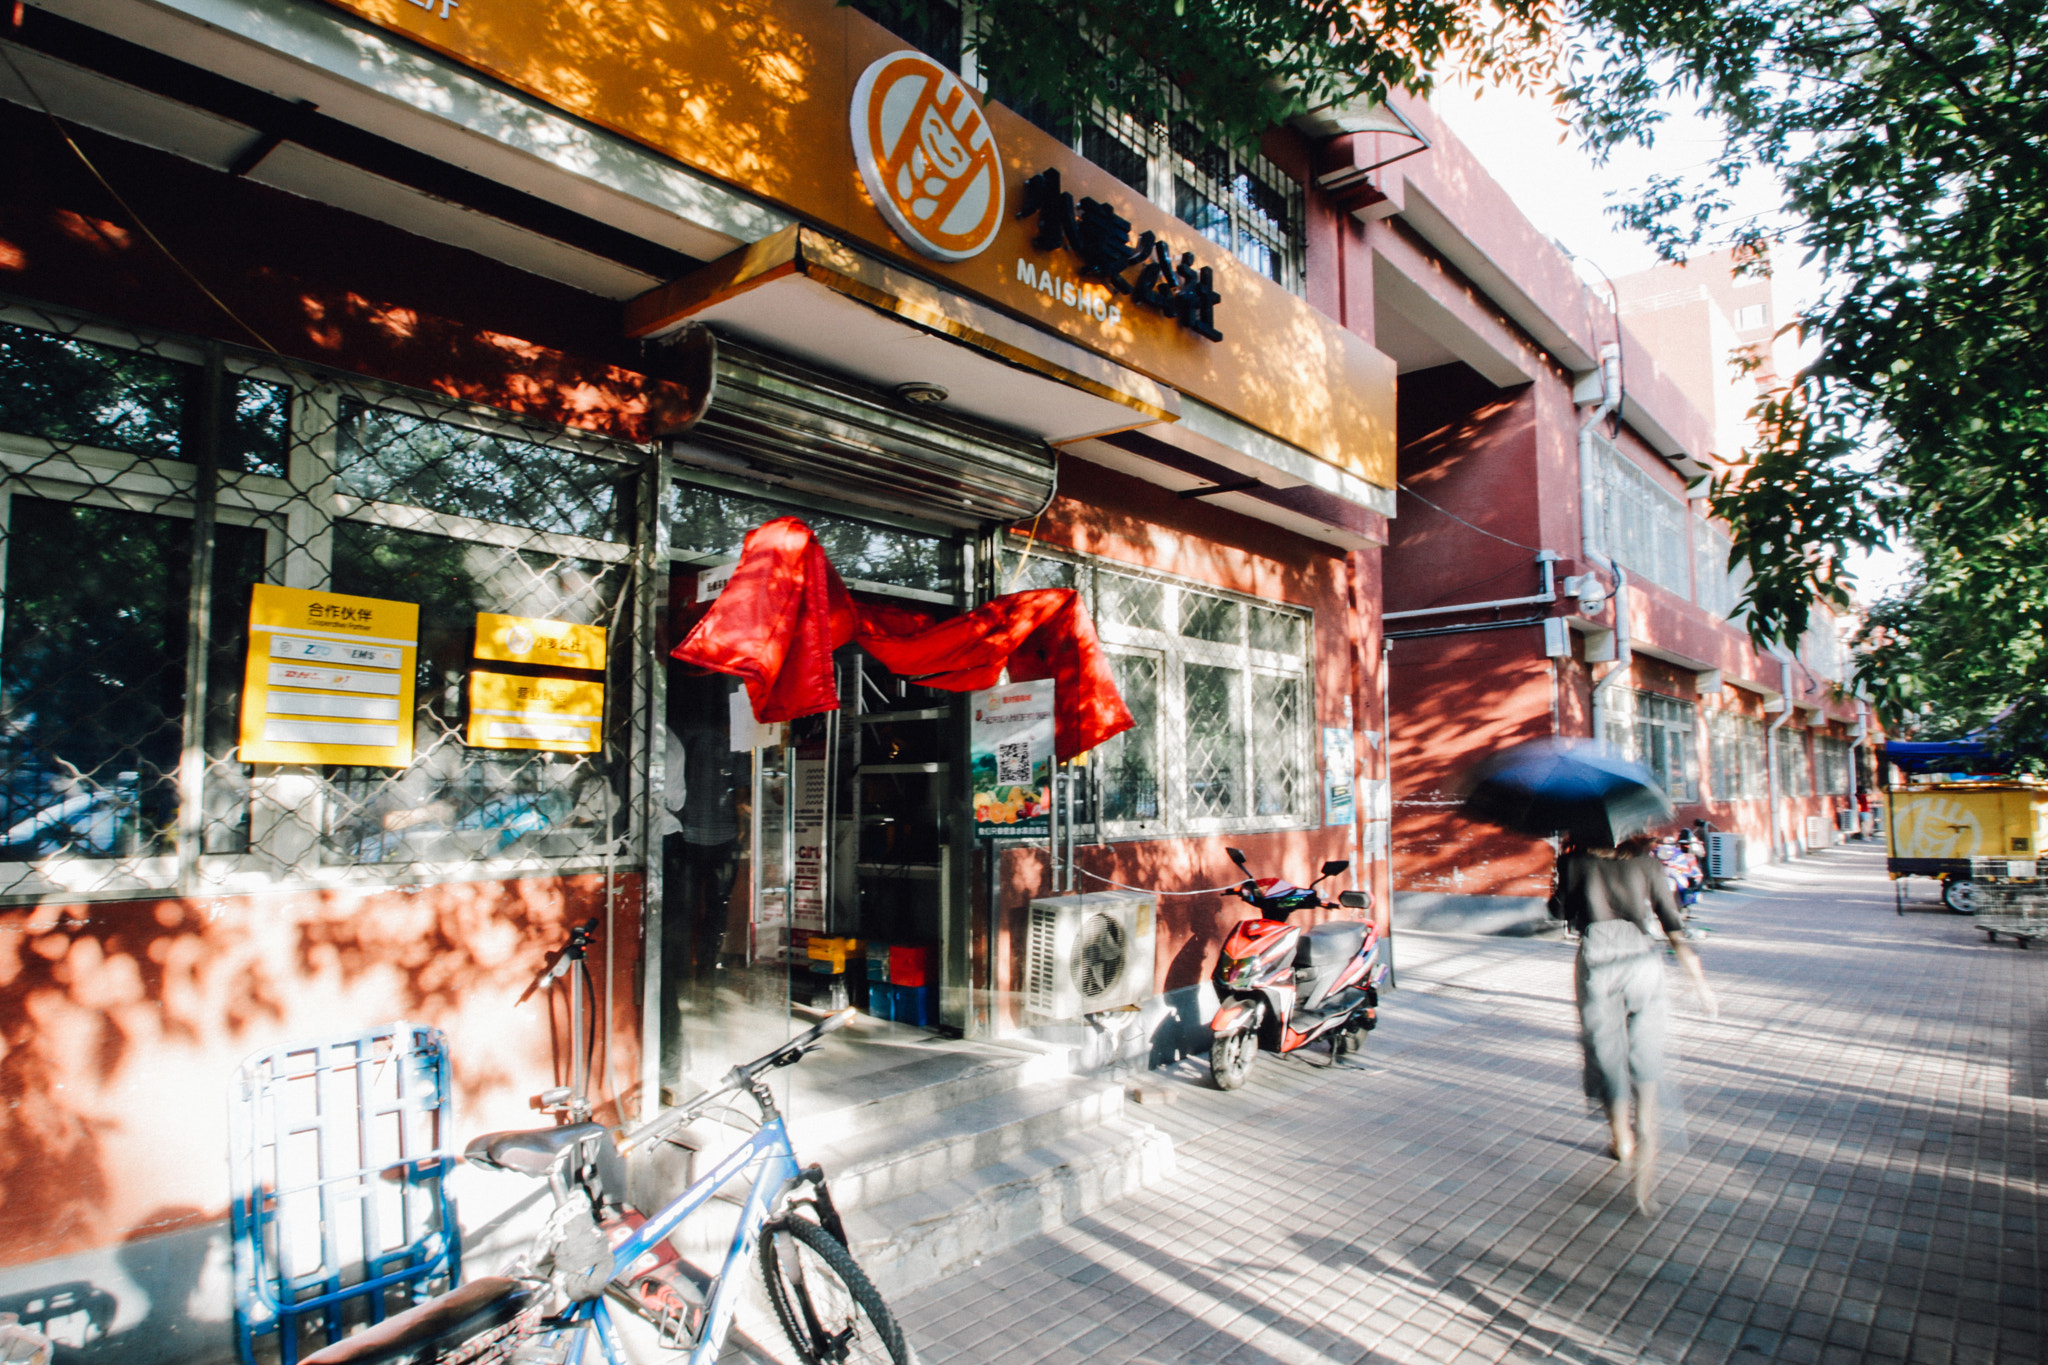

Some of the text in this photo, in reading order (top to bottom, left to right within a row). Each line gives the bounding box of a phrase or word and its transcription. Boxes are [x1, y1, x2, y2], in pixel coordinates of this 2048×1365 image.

[1014, 166, 1225, 343] 小麦公社
[1016, 257, 1122, 327] MAISHOP
[308, 602, 373, 622] 合作伙伴
[351, 649, 376, 660] EMS
